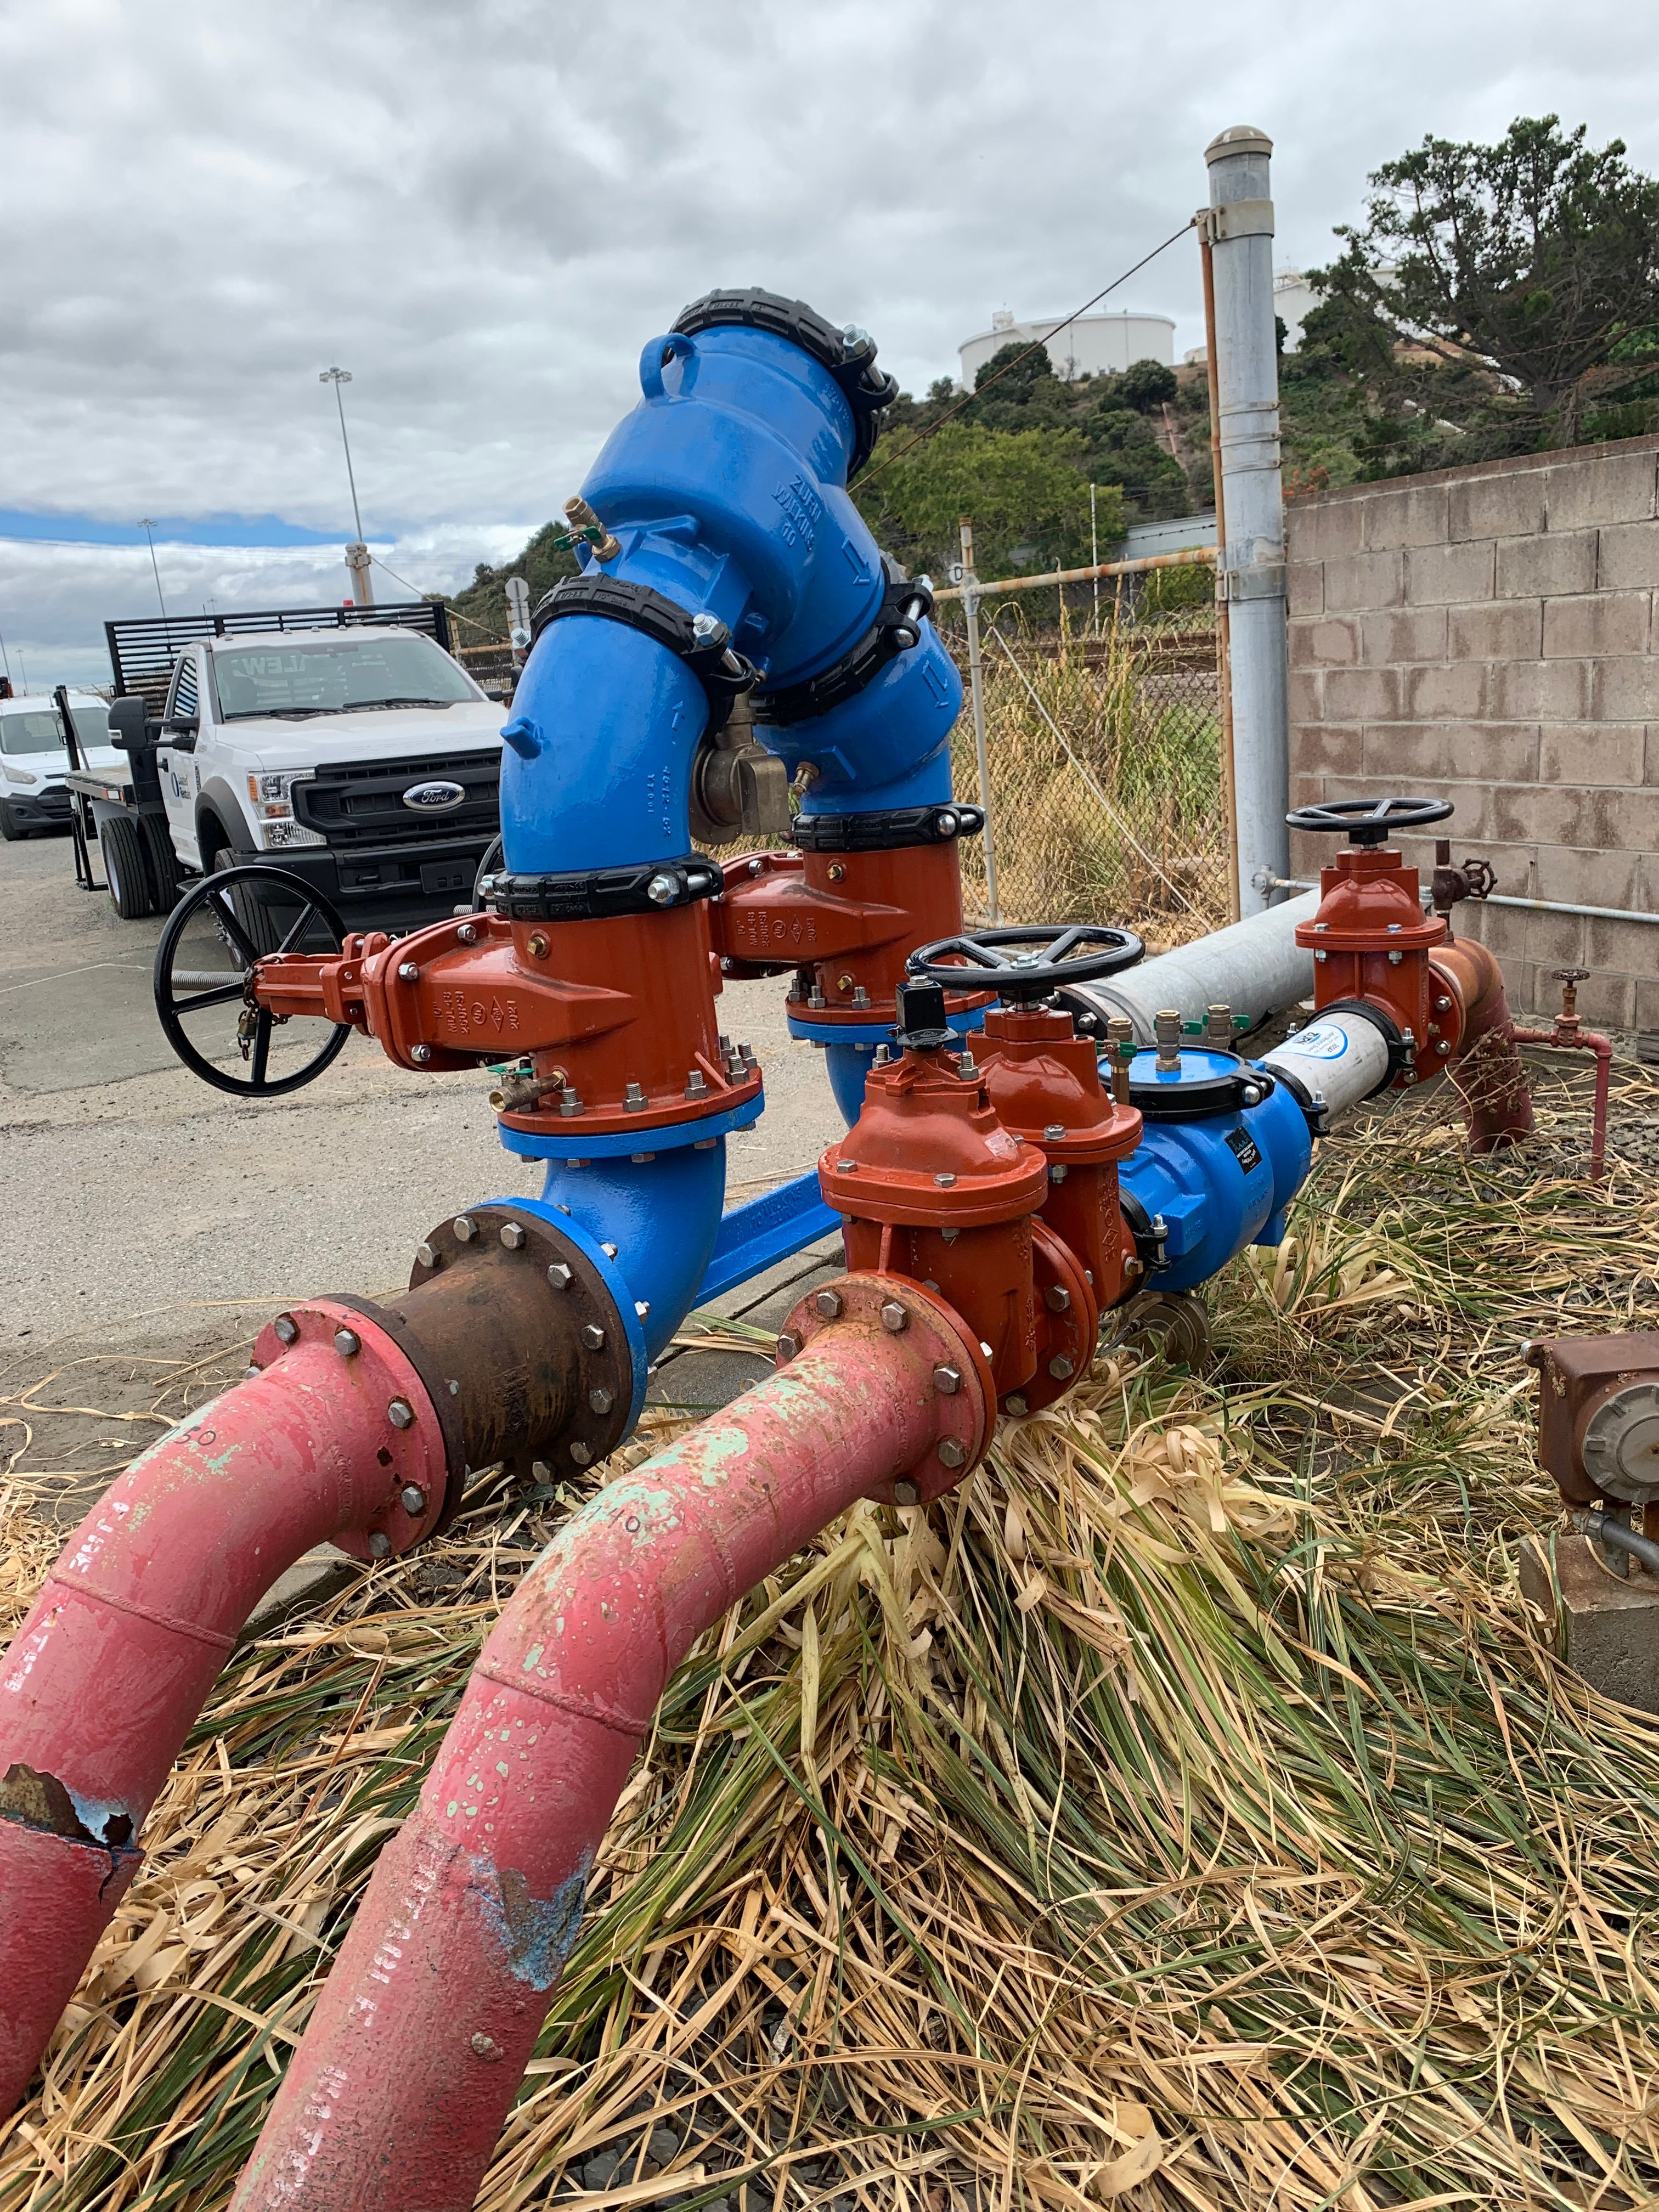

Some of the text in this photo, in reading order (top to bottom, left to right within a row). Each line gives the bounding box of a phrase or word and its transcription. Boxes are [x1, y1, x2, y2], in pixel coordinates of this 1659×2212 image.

[421, 788, 450, 804] Ford
[805, 917, 817, 942] 2021
[454, 990, 470, 1035] 250PSI
[506, 1000, 520, 1031] 2021
